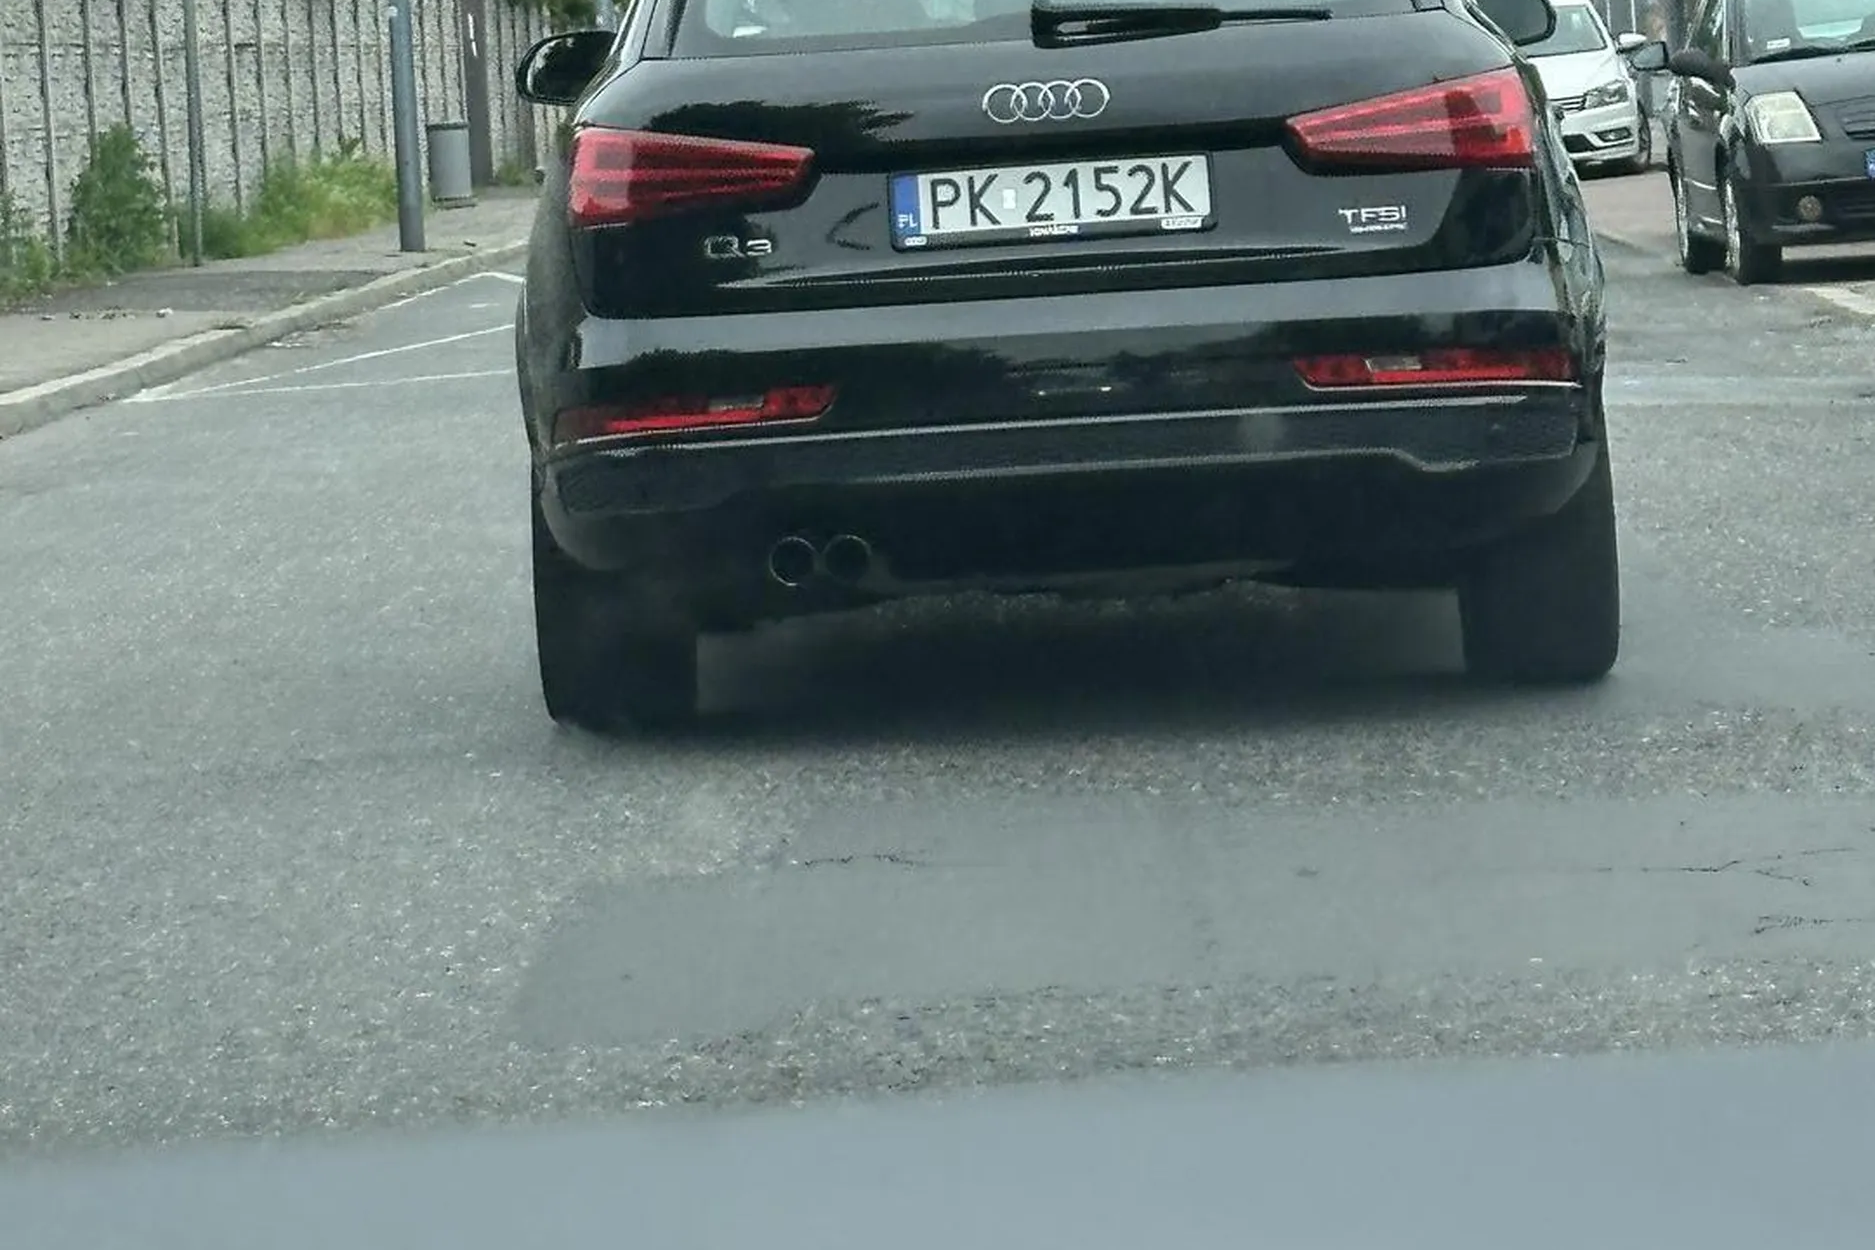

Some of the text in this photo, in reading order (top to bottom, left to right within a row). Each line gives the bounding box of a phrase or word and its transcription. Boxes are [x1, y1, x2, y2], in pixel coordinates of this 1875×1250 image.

[930, 160, 1195, 230] PK 2152K
[1338, 205, 1407, 224] TFSI
[704, 236, 772, 258] Q3
